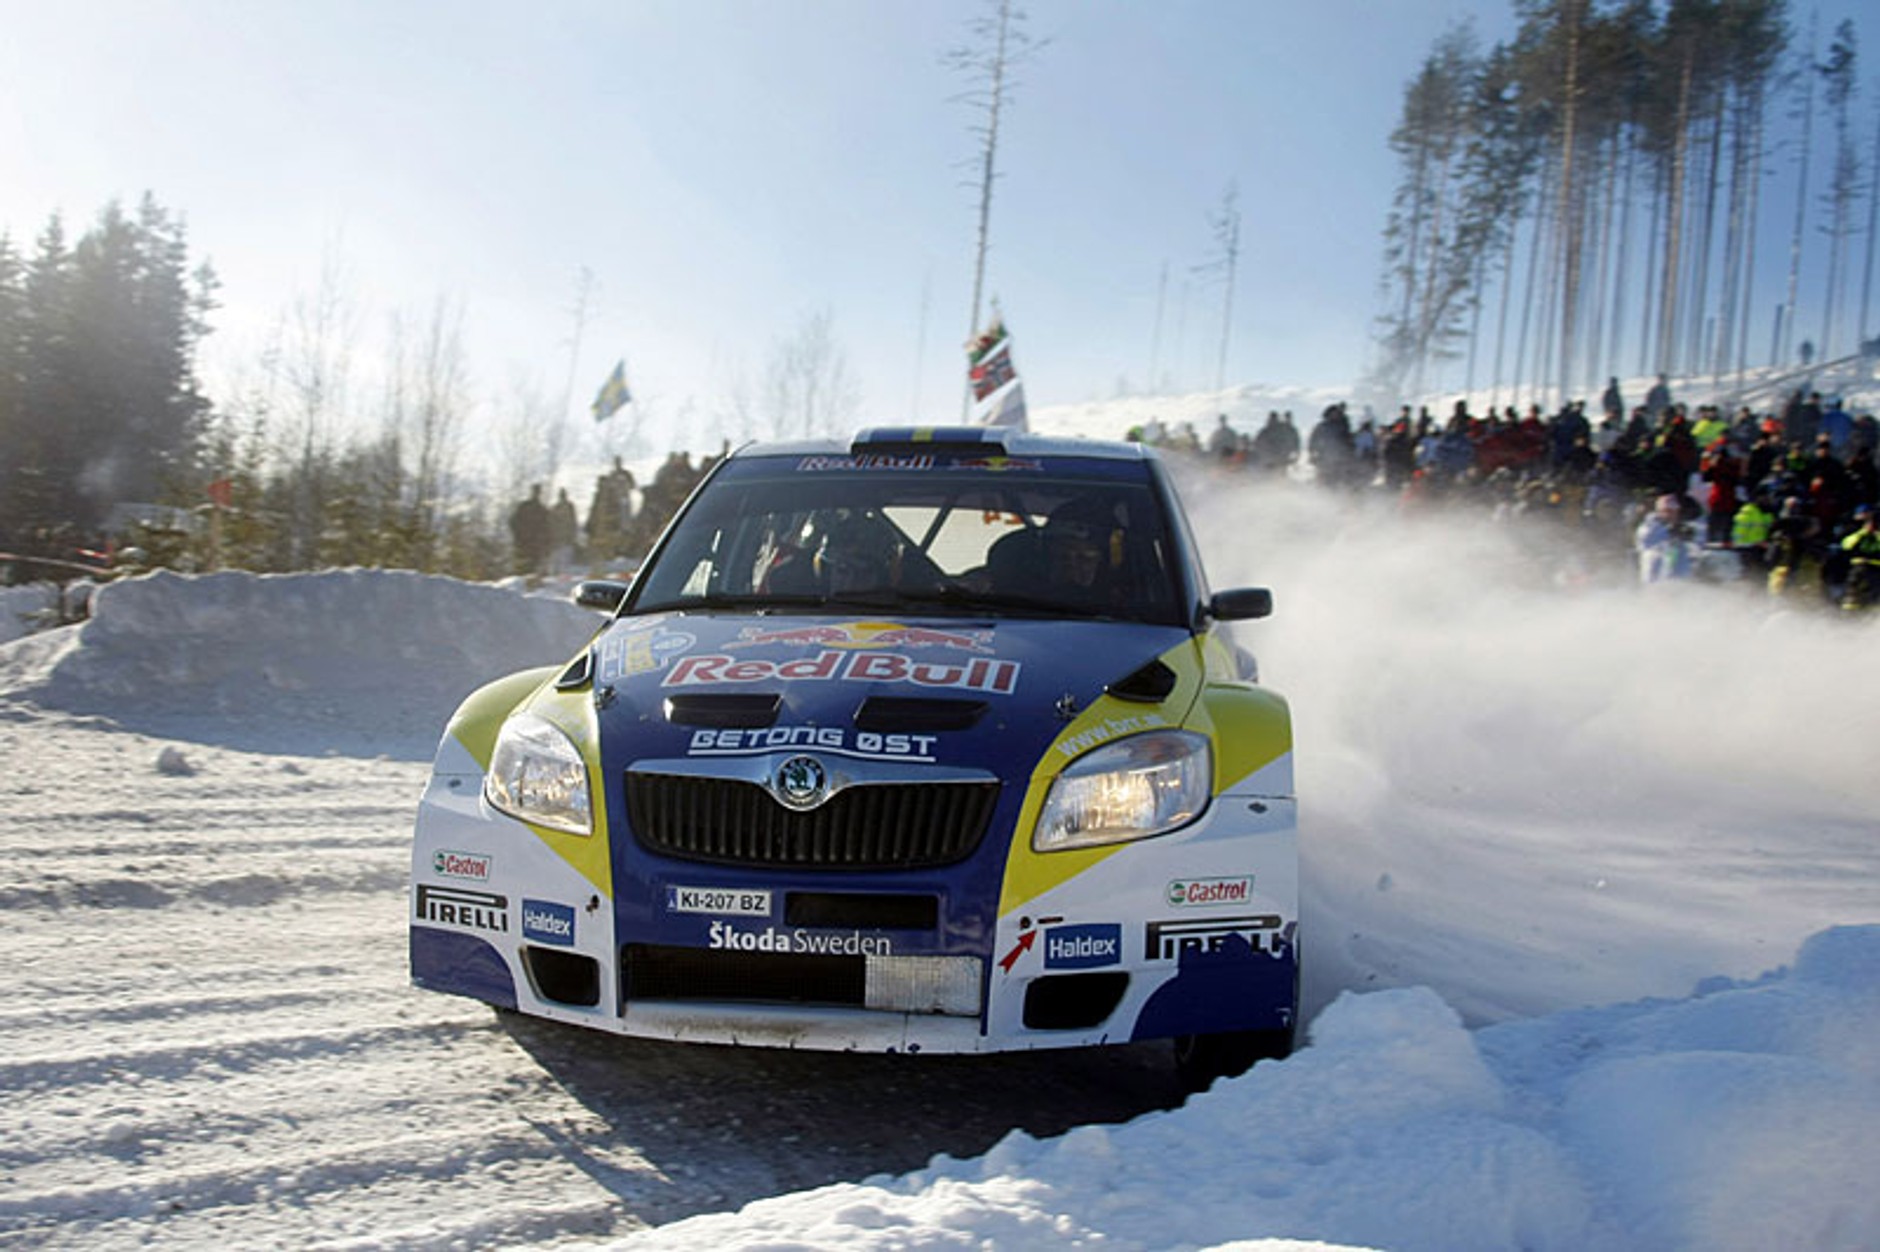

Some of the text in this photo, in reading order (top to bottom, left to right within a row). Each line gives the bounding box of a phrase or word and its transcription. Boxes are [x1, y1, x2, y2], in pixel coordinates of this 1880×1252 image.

[797, 454, 866, 471] Red
[662, 651, 845, 687] Red
[845, 651, 1020, 694] Bull
[690, 727, 937, 755] BETONG ØST
[445, 855, 487, 877] Castrol
[680, 891, 766, 911] KI-207 BZ
[1187, 880, 1248, 903] Castrol
[416, 883, 509, 932] PIRELLI
[524, 909, 571, 936] Haldex
[708, 921, 891, 955] Škoda Sweden
[1049, 936, 1116, 959] Haldex
